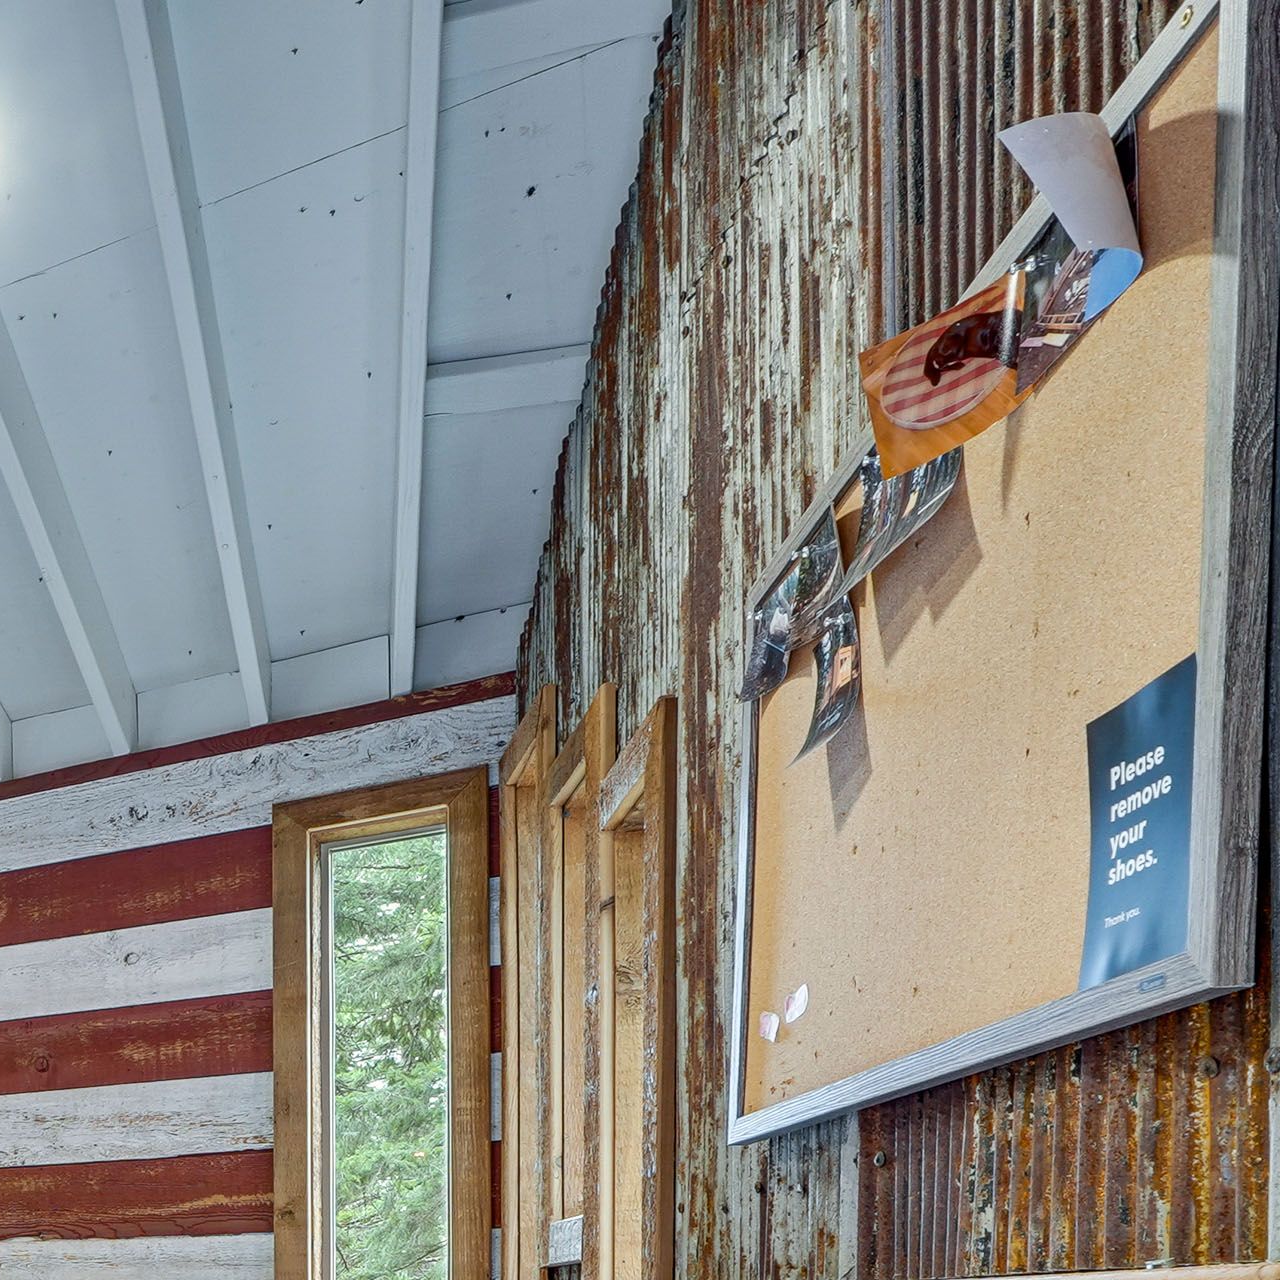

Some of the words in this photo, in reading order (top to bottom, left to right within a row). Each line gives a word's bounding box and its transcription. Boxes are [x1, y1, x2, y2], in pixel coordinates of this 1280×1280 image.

[1110, 745, 1165, 791] Please
[1110, 775, 1172, 822] remove
[1110, 820, 1147, 859] your
[1108, 849, 1158, 885] shoes.
[1104, 911, 1125, 928] Thank
